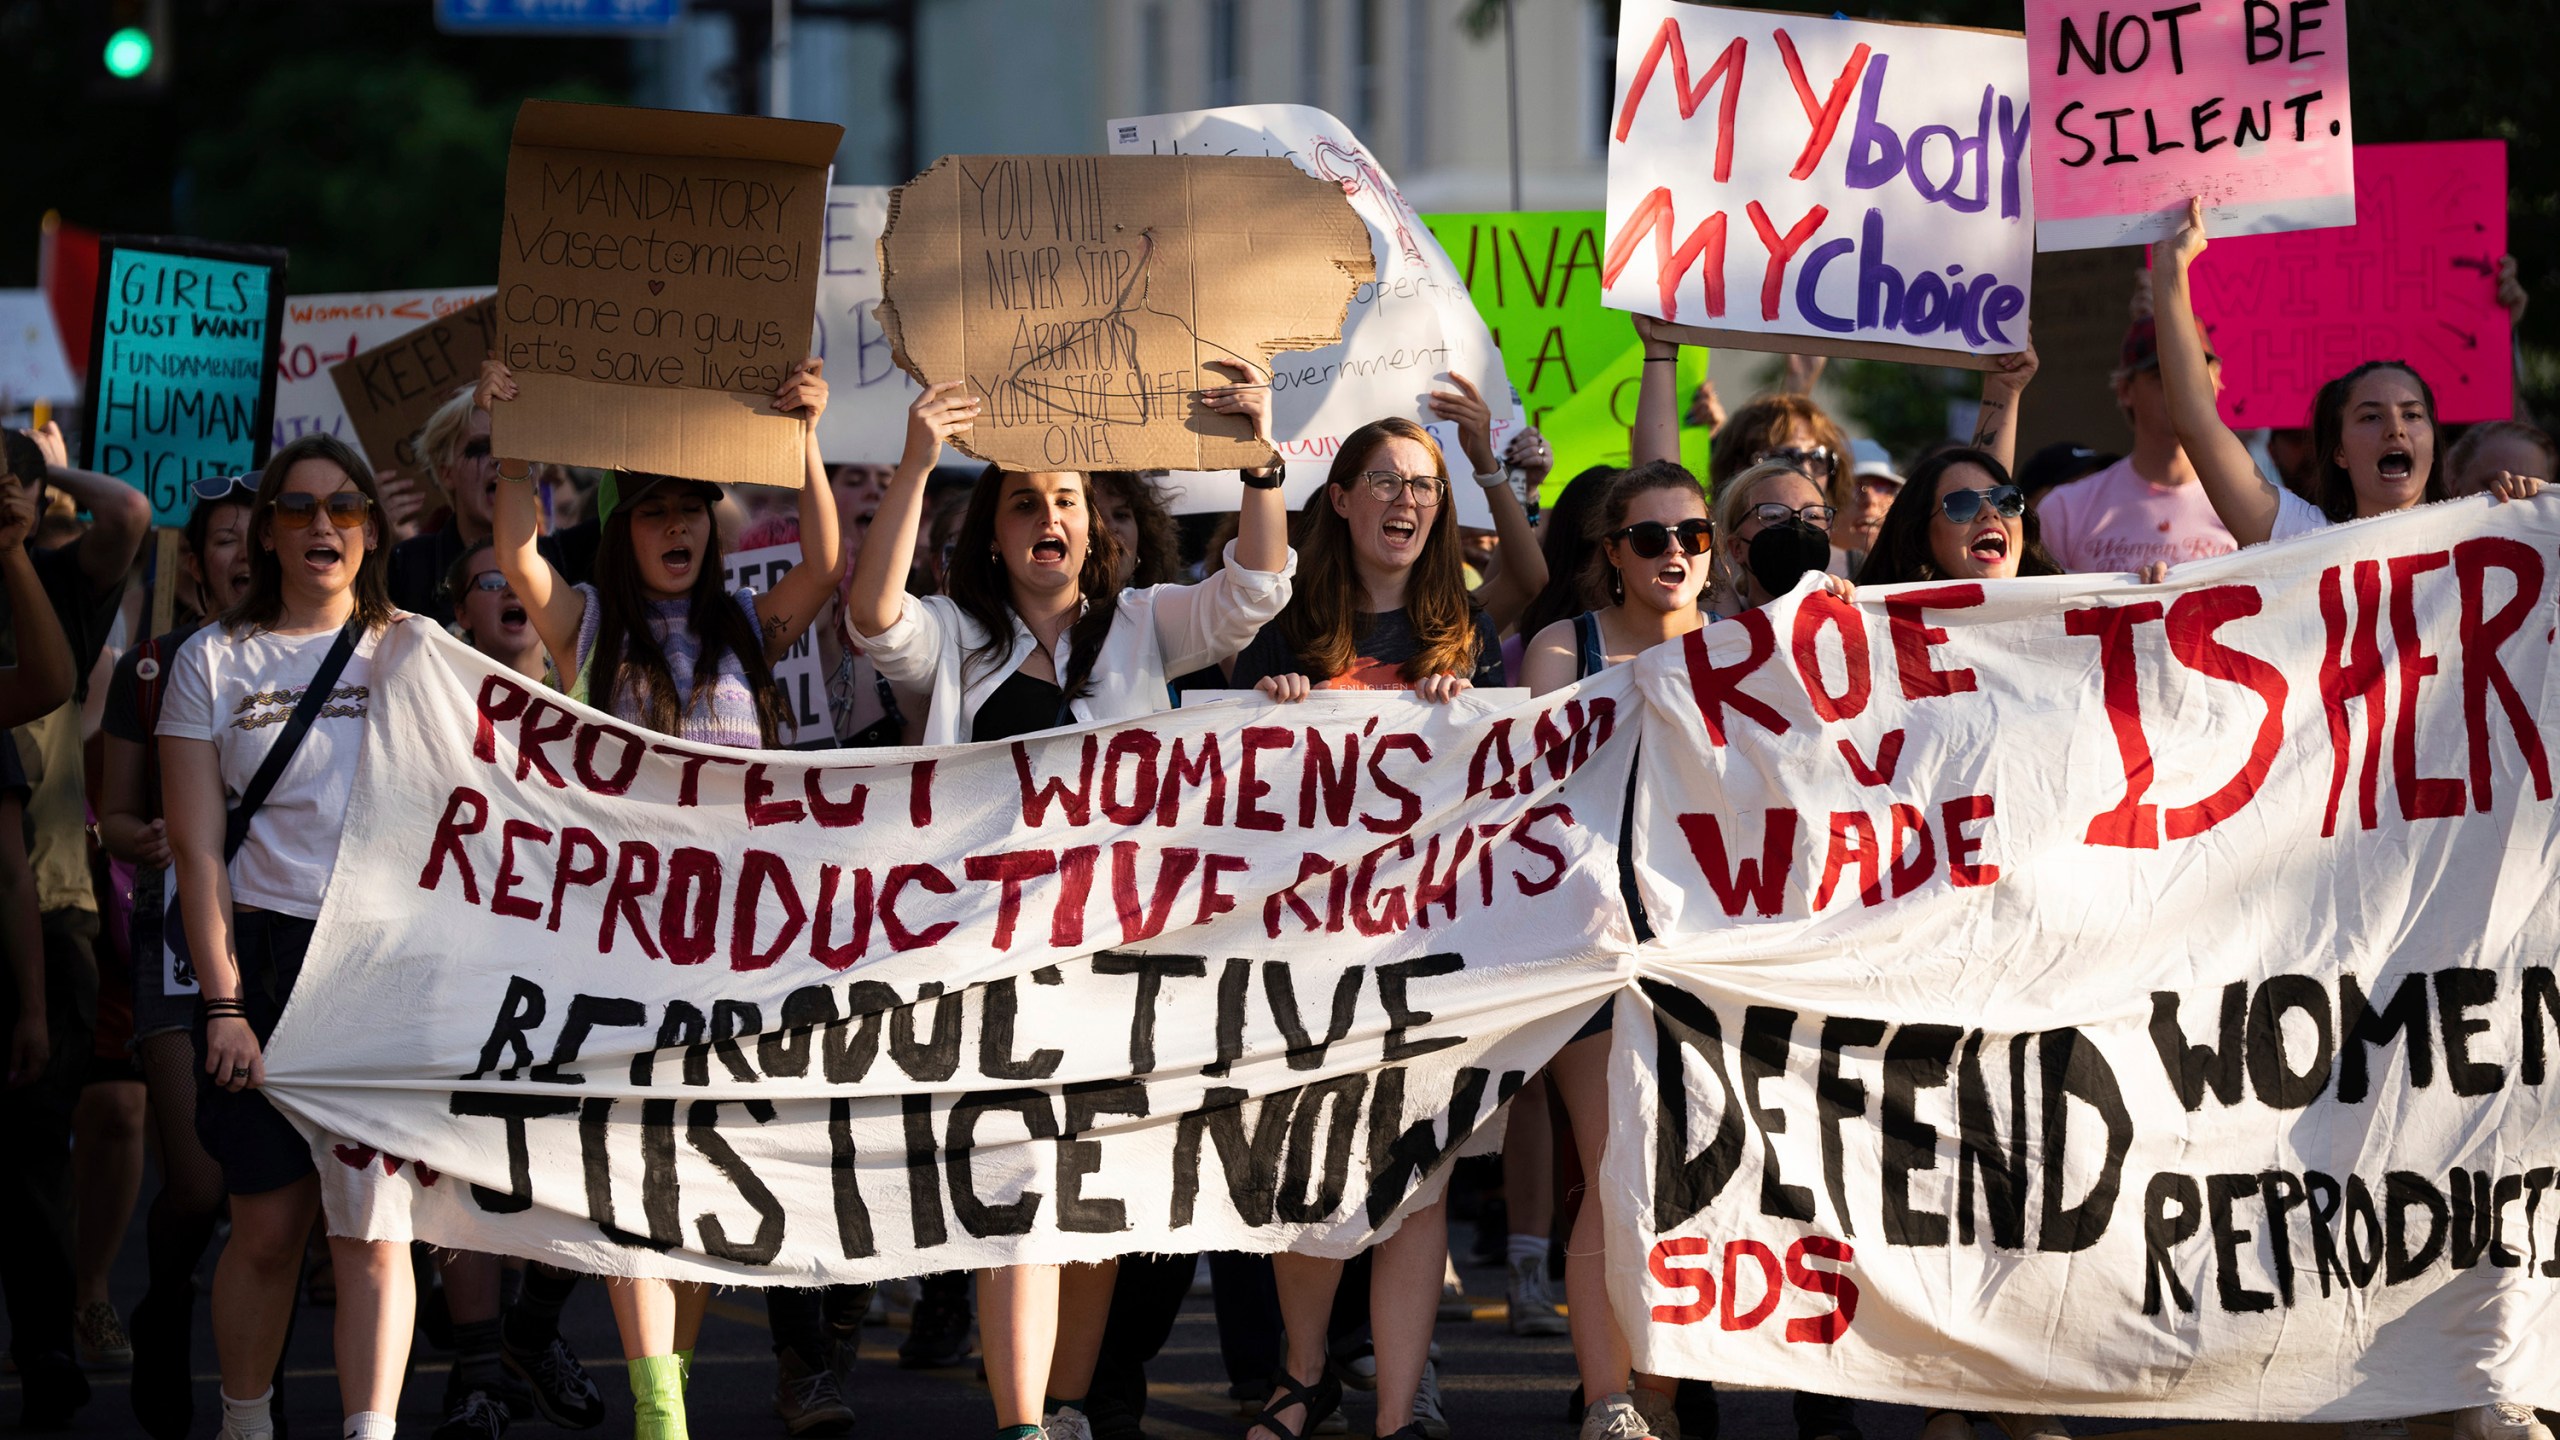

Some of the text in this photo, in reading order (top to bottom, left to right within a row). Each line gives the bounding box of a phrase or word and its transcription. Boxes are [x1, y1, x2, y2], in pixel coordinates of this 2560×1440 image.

[2057, 0, 2328, 76] NOT BE
[1615, 16, 1872, 184] MY
[2055, 90, 2341, 168] SILENT.
[542, 161, 796, 234] MANDATORY
[960, 158, 1034, 242] YOU
[1043, 156, 1106, 245] WILL
[511, 212, 802, 283] Vasectomies!
[985, 244, 1131, 311] NEVER STOP
[1602, 185, 2025, 347] MY Choice
[2200, 247, 2438, 318] WITH
[109, 308, 266, 341] JUST WANT
[120, 262, 250, 314] GIRLS
[290, 303, 385, 324] Women
[504, 283, 622, 334] Come
[633, 306, 684, 339] on
[694, 311, 786, 359] guys,
[1353, 274, 1453, 318] operty
[356, 325, 459, 414] KEEP
[503, 333, 577, 373] let's
[590, 346, 685, 385] save
[1007, 313, 1138, 372] ABORTION.
[104, 376, 258, 443] HUMAN
[969, 369, 1192, 430] YOU'LL STOP SAFE
[1044, 421, 1120, 466] ONES.
[1339, 683, 1409, 691] ENLIGHTEN
[1682, 583, 1986, 747] ROE
[2064, 536, 2554, 849] IS HER
[473, 673, 938, 831] PROTECT
[1011, 696, 1617, 835] WOMEN'S AND
[418, 786, 1576, 972] REPRODUCTIVE RIGHTS
[1676, 794, 2000, 919] WADE
[458, 952, 1467, 1086] REPRODUCTIVE
[1639, 976, 2134, 1253] DEFEND
[449, 1077, 1151, 1266] JUSTICE
[1648, 1235, 1860, 1344] SDS
